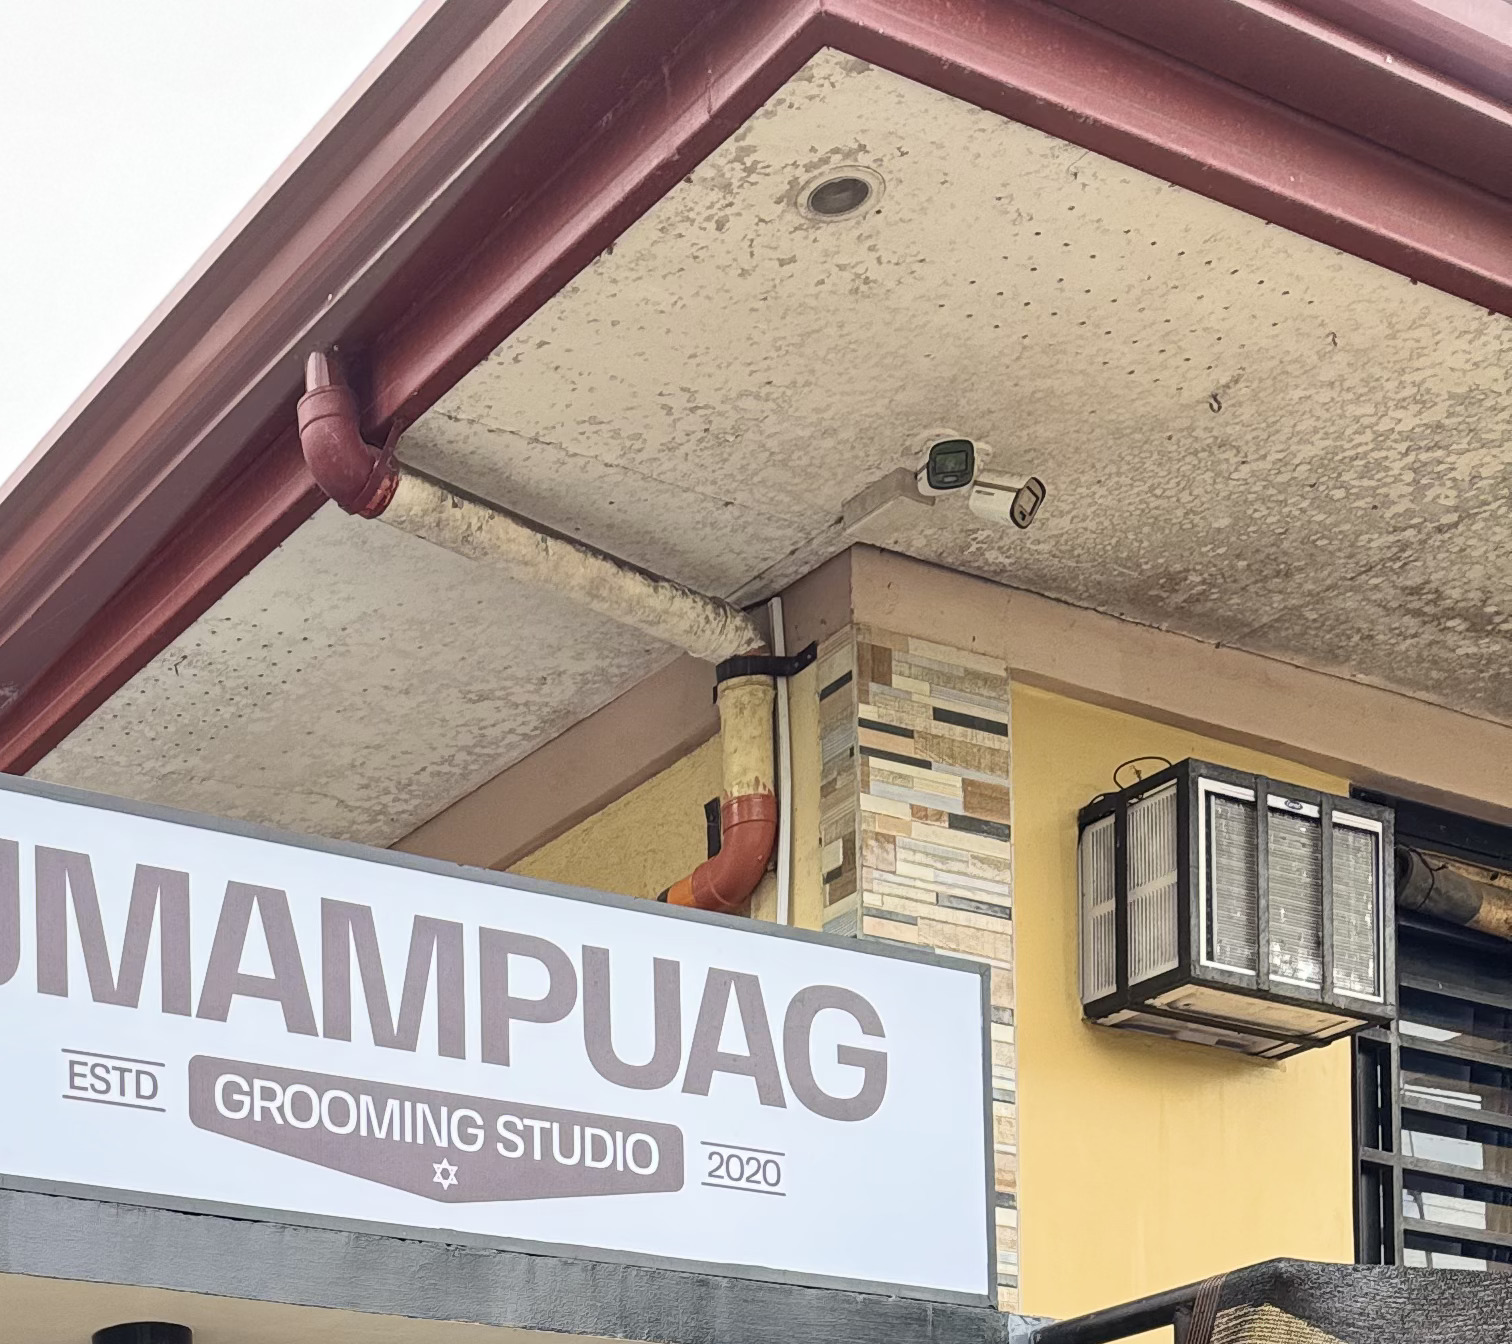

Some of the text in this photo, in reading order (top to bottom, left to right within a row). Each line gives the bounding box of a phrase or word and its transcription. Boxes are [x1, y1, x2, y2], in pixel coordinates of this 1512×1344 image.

[67, 1059, 159, 1102] ESTD
[214, 1073, 659, 1177] GROOMING STUDIO
[707, 1150, 783, 1190] 2020
